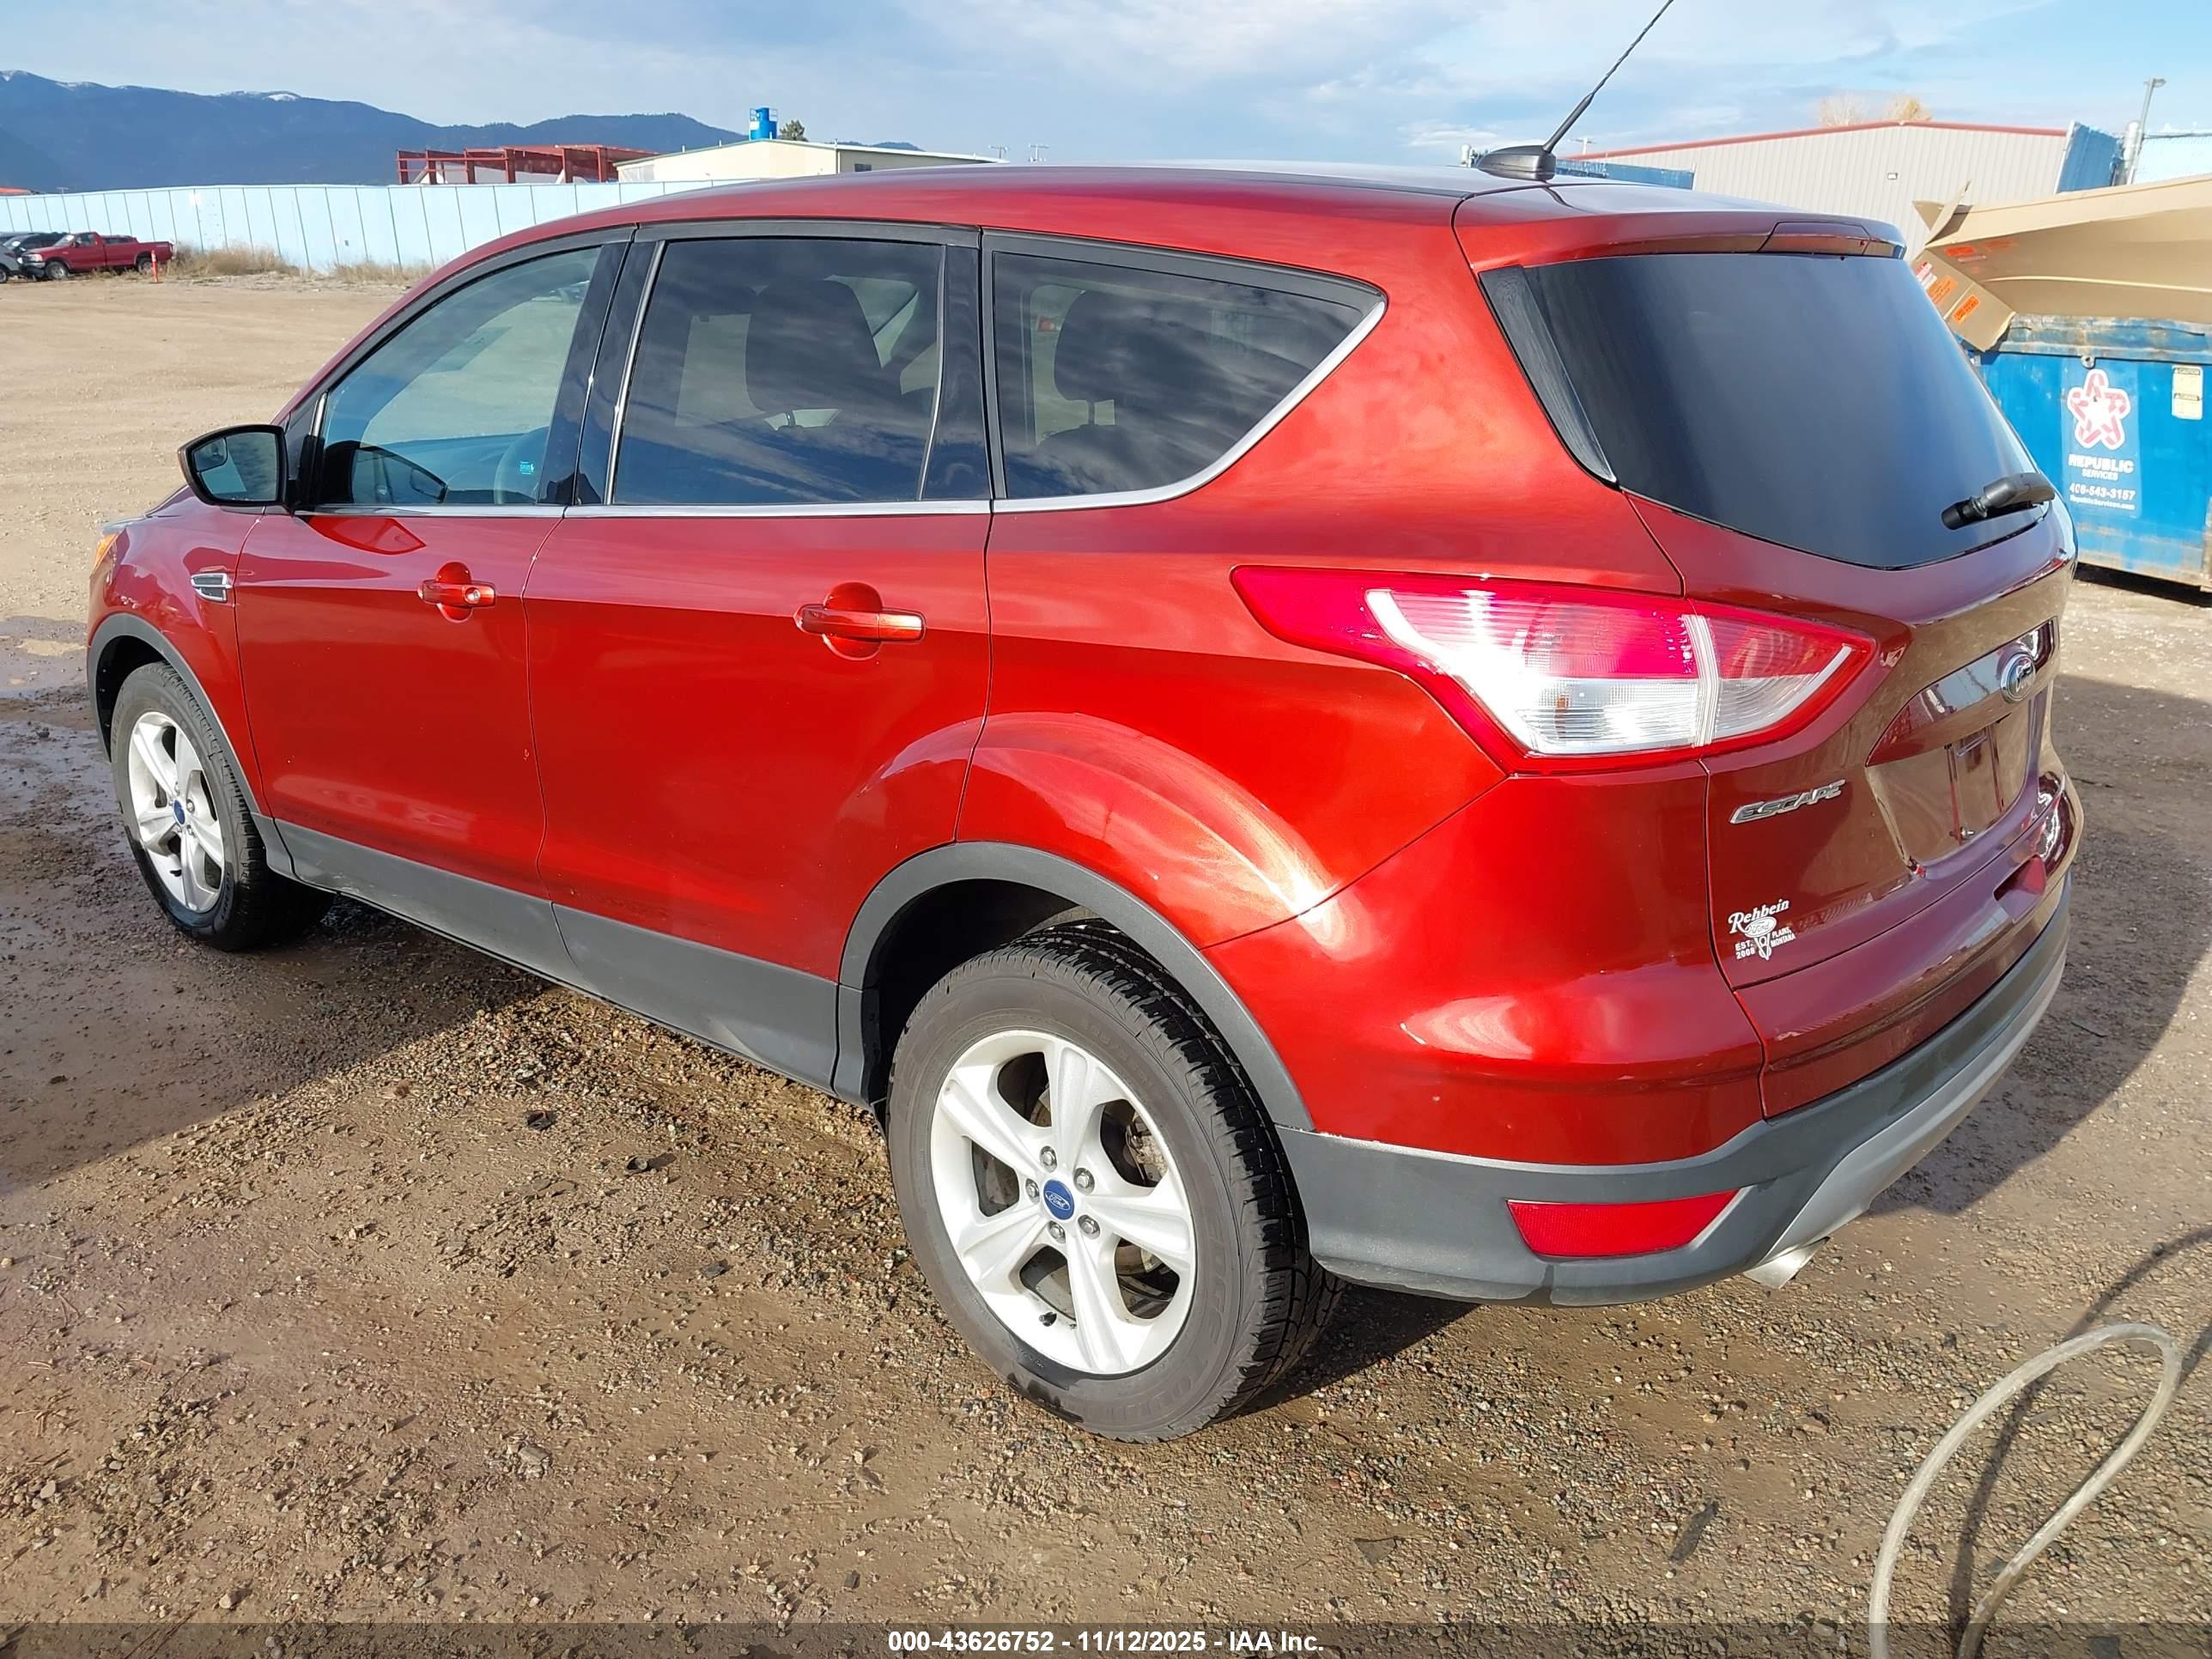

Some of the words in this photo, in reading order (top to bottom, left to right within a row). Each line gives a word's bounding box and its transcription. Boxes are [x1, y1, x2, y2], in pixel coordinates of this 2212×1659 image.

[2068, 453, 2134, 473] REPUBLIC
[2081, 468, 2118, 481] SERVICES
[1729, 779, 1846, 824] ESCAPE
[1728, 898, 1790, 933] Rehbein
[1735, 939, 1753, 951] EST.
[1770, 933, 1796, 948] MONTANA
